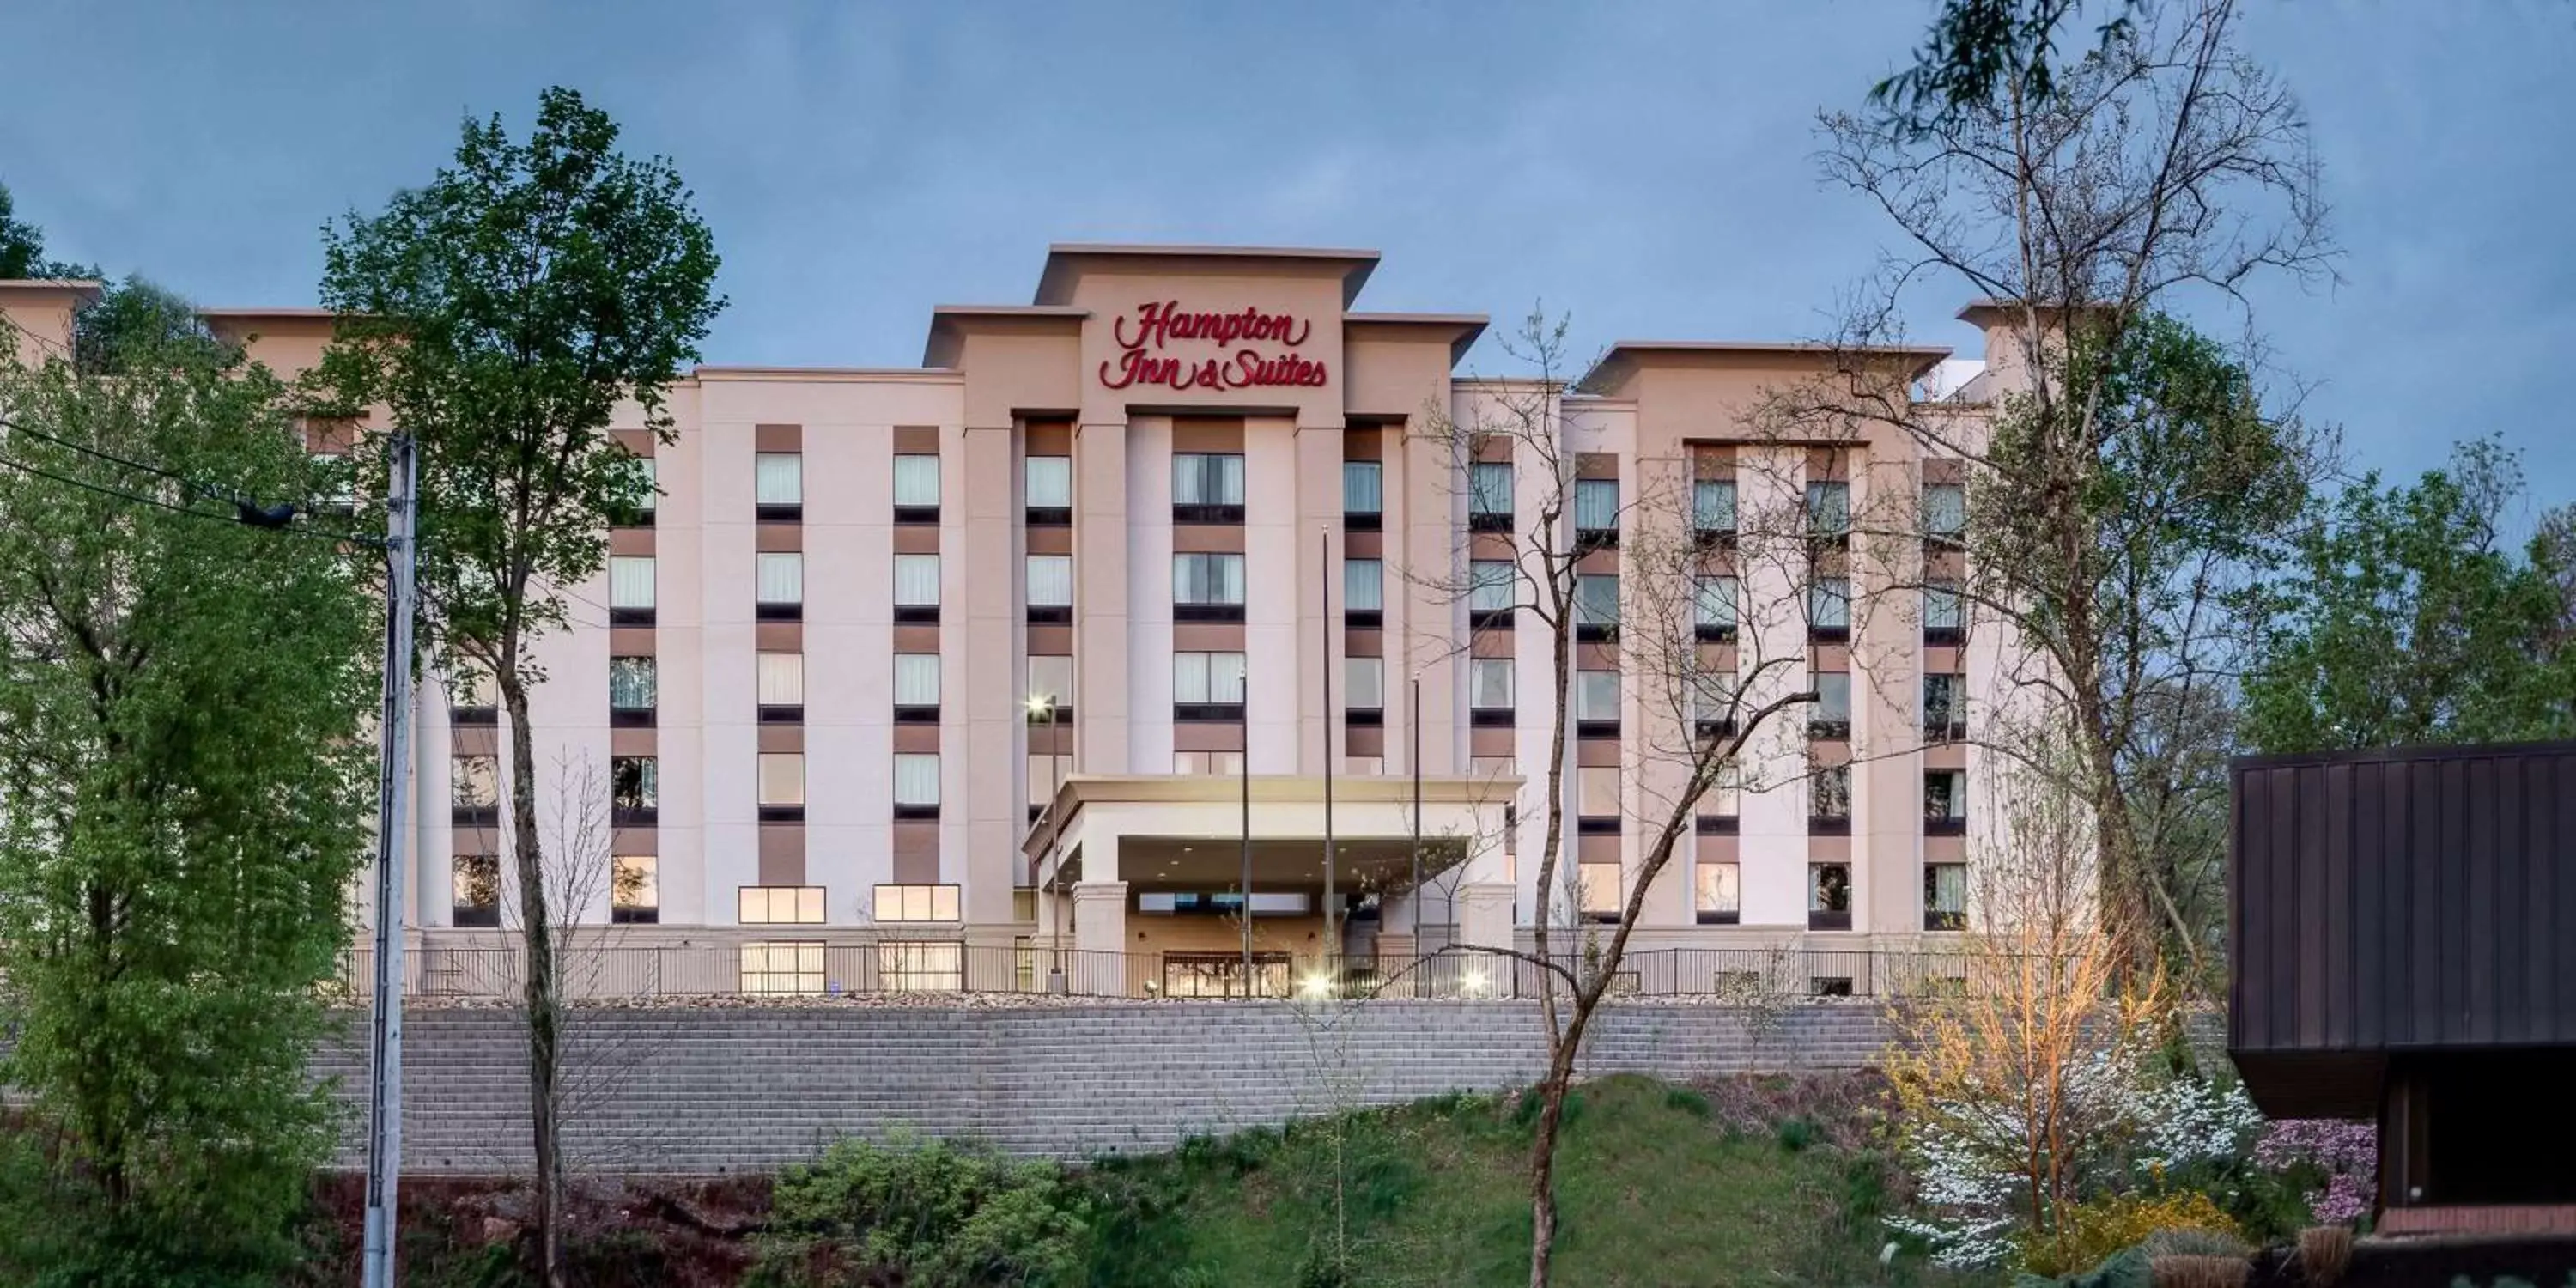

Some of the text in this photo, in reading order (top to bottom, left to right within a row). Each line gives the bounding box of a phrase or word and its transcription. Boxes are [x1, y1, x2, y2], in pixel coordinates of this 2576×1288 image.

[1115, 301, 1310, 349] Hampton
[1100, 348, 1327, 392] Inn & Suites
